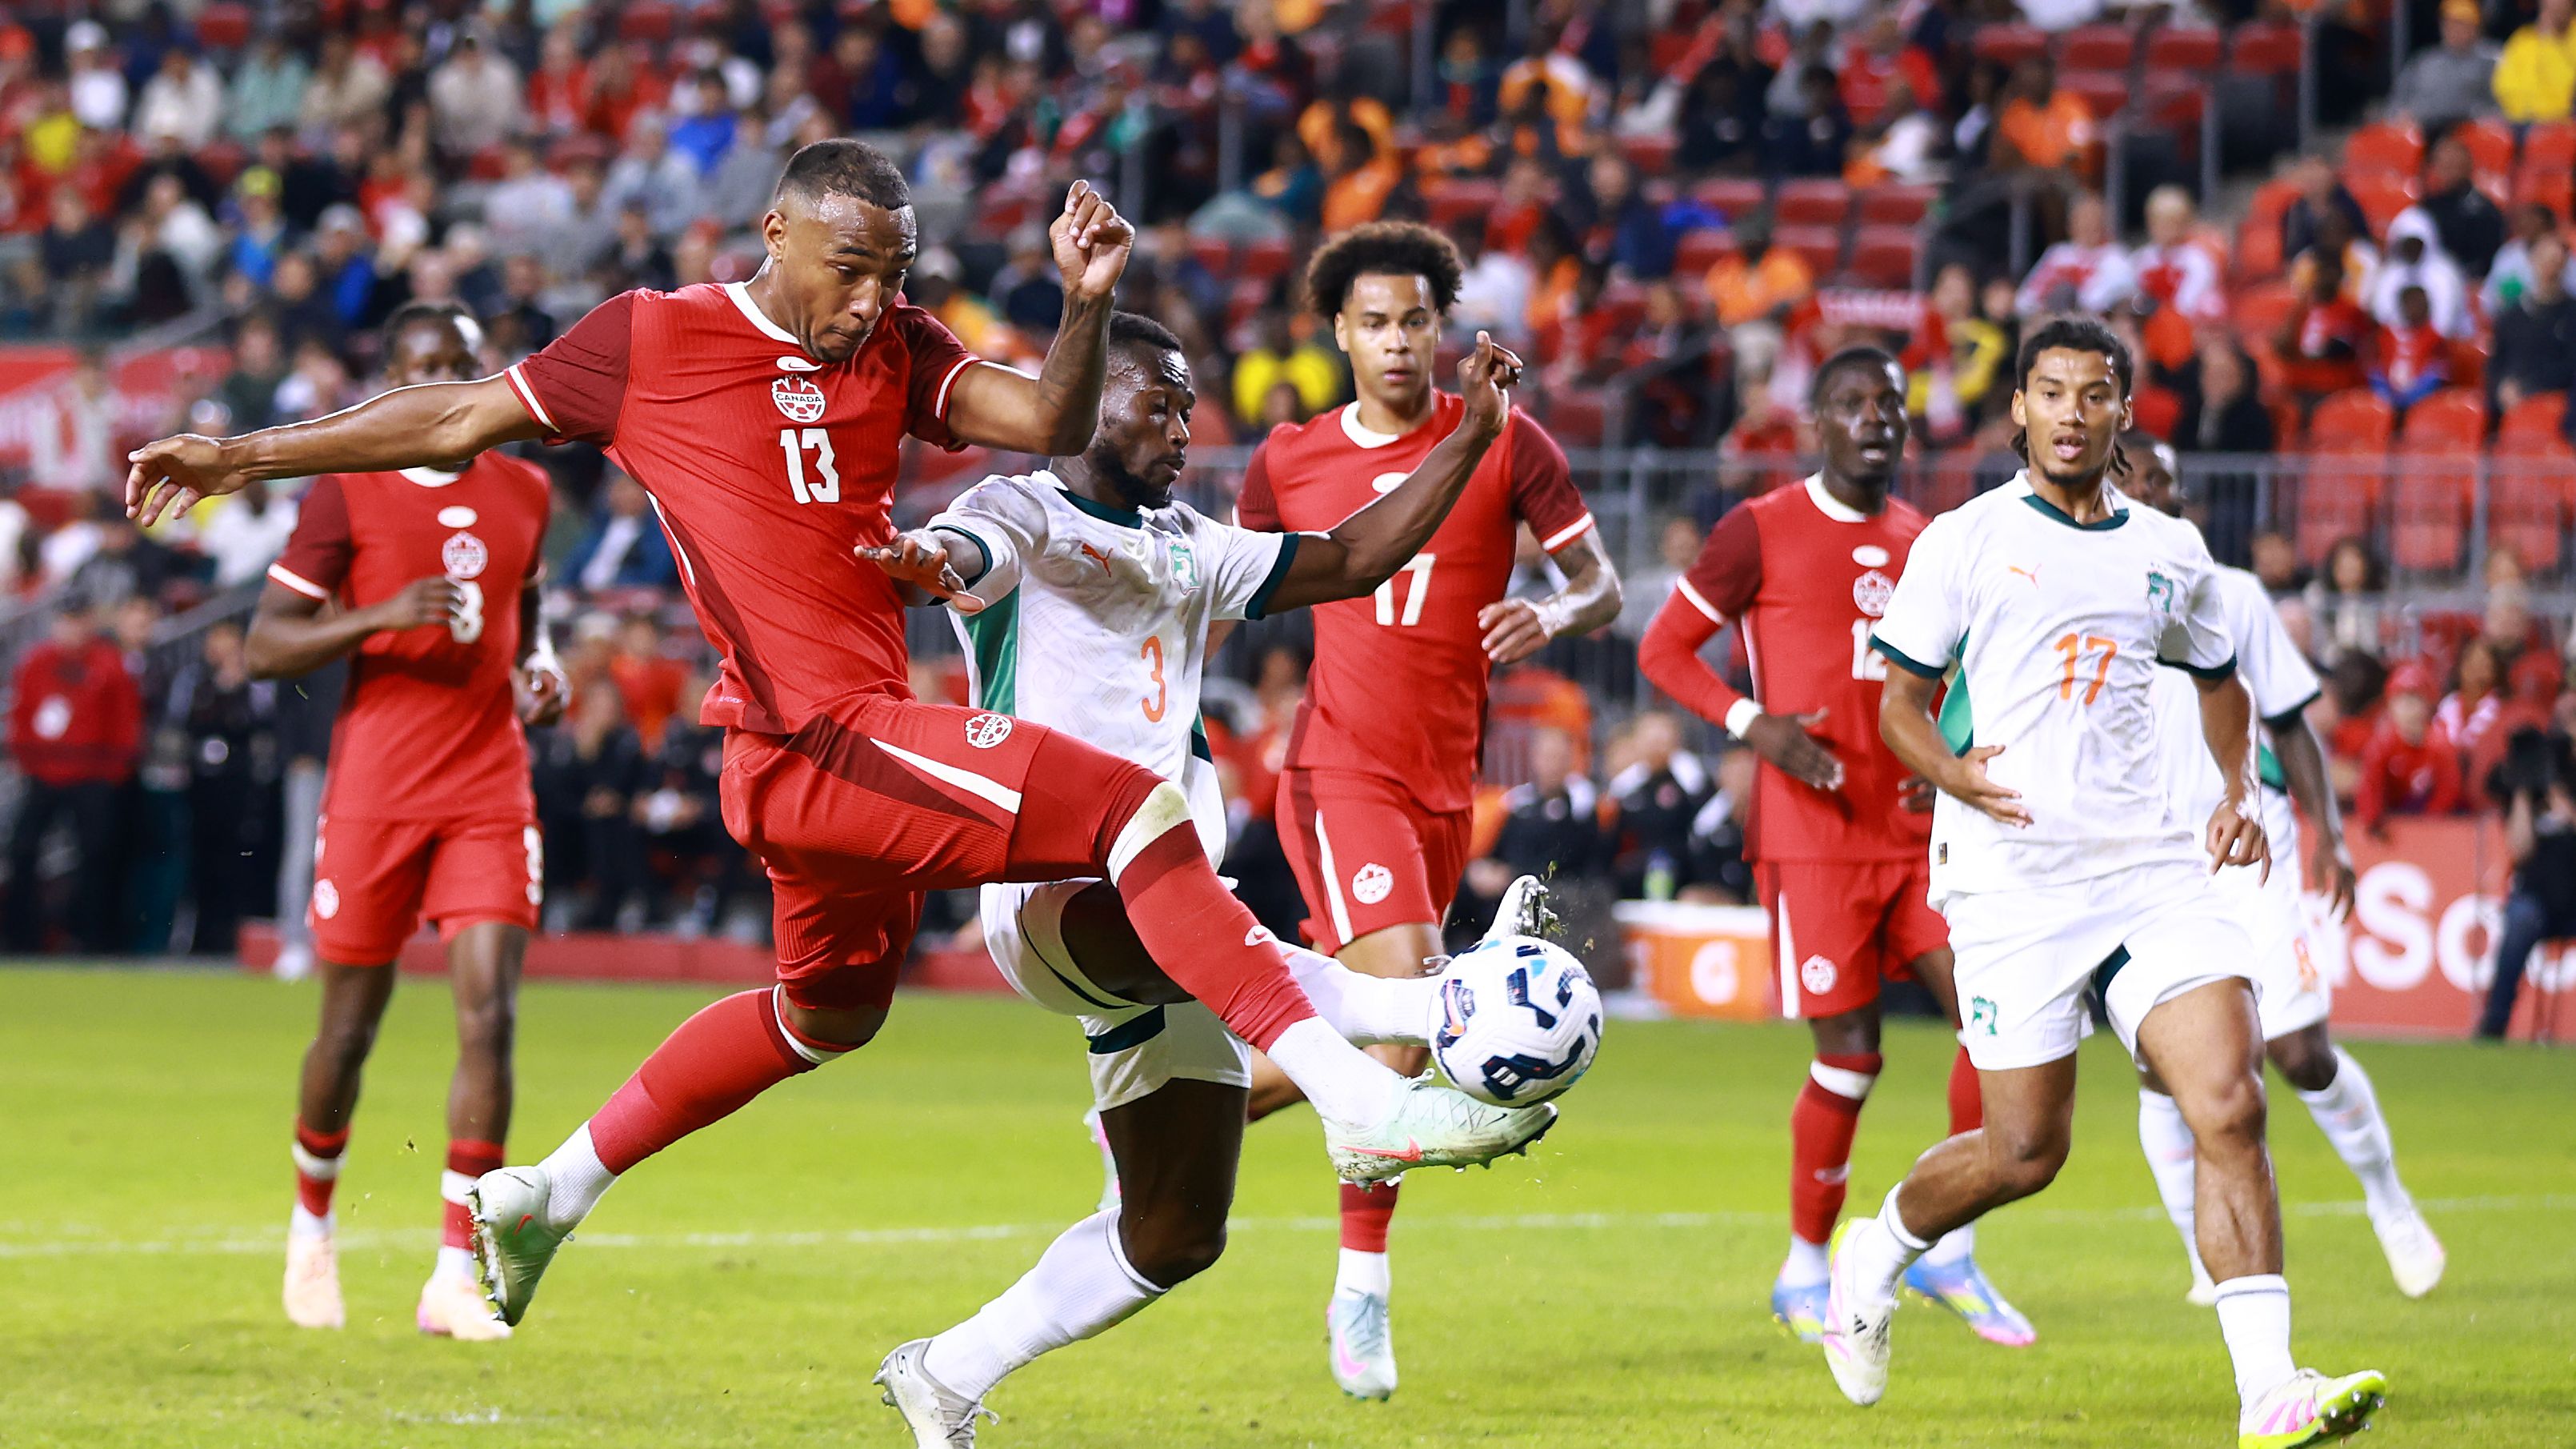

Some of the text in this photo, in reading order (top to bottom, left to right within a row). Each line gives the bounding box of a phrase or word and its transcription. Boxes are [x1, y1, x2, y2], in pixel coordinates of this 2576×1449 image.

[775, 393, 822, 403] CANADA
[780, 428, 840, 504] 13
[1374, 553, 1437, 626] 17
[1141, 635, 1166, 723] 3
[2054, 632, 2118, 706] 17
